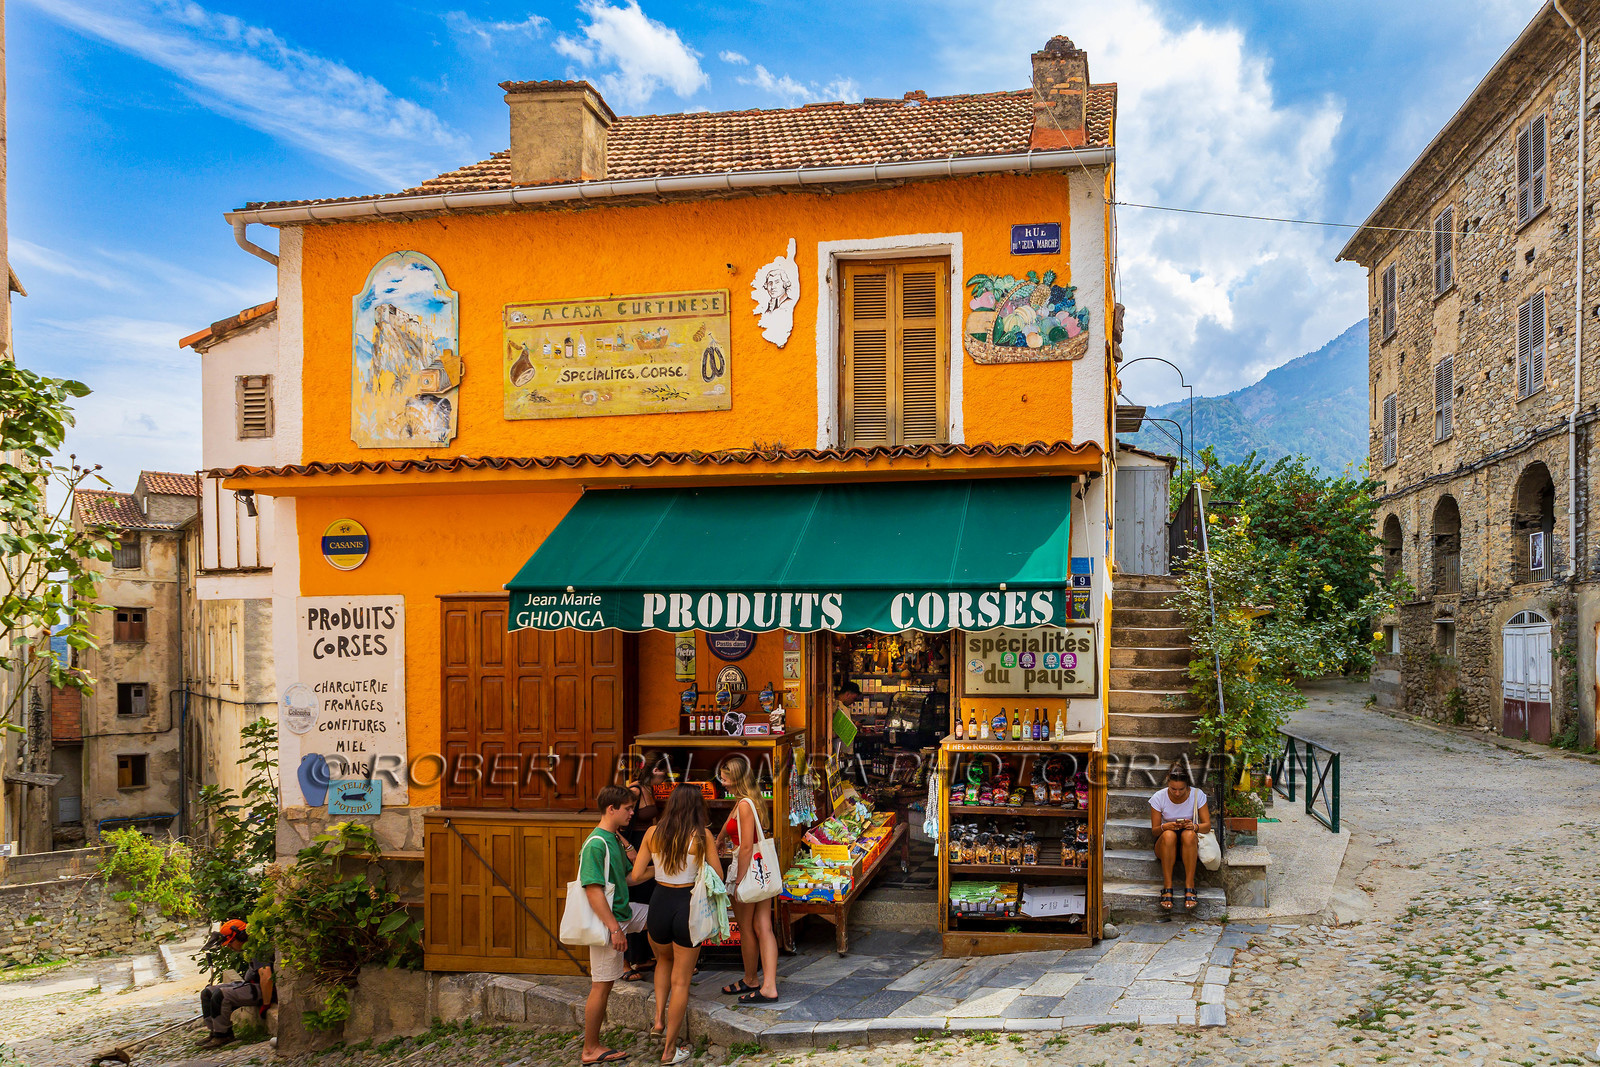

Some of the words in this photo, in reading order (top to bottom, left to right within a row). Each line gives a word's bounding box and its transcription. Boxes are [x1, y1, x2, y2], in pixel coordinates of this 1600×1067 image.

[543, 308, 553, 320] A
[562, 305, 602, 318] CASA
[617, 297, 720, 315] CURTINESE
[1080, 576, 1086, 586] 9
[524, 593, 556, 606] Jean
[560, 593, 601, 606] Marie
[641, 592, 843, 629] PRODUITS
[890, 590, 1054, 628] CORSES
[308, 606, 396, 630] PRODUITS
[516, 610, 605, 628] GHIONGA
[313, 634, 388, 660] CORSES
[969, 632, 1090, 658] spécialités
[984, 663, 1010, 684] du
[314, 678, 388, 693] CHARCUTERIE
[324, 699, 384, 712] FROMAGES
[318, 720, 386, 732] CONFITURES
[336, 740, 366, 752] MIEL
[340, 761, 370, 779] VINS
[336, 782, 374, 795] ATELIER
[334, 800, 372, 814] POTERIE
